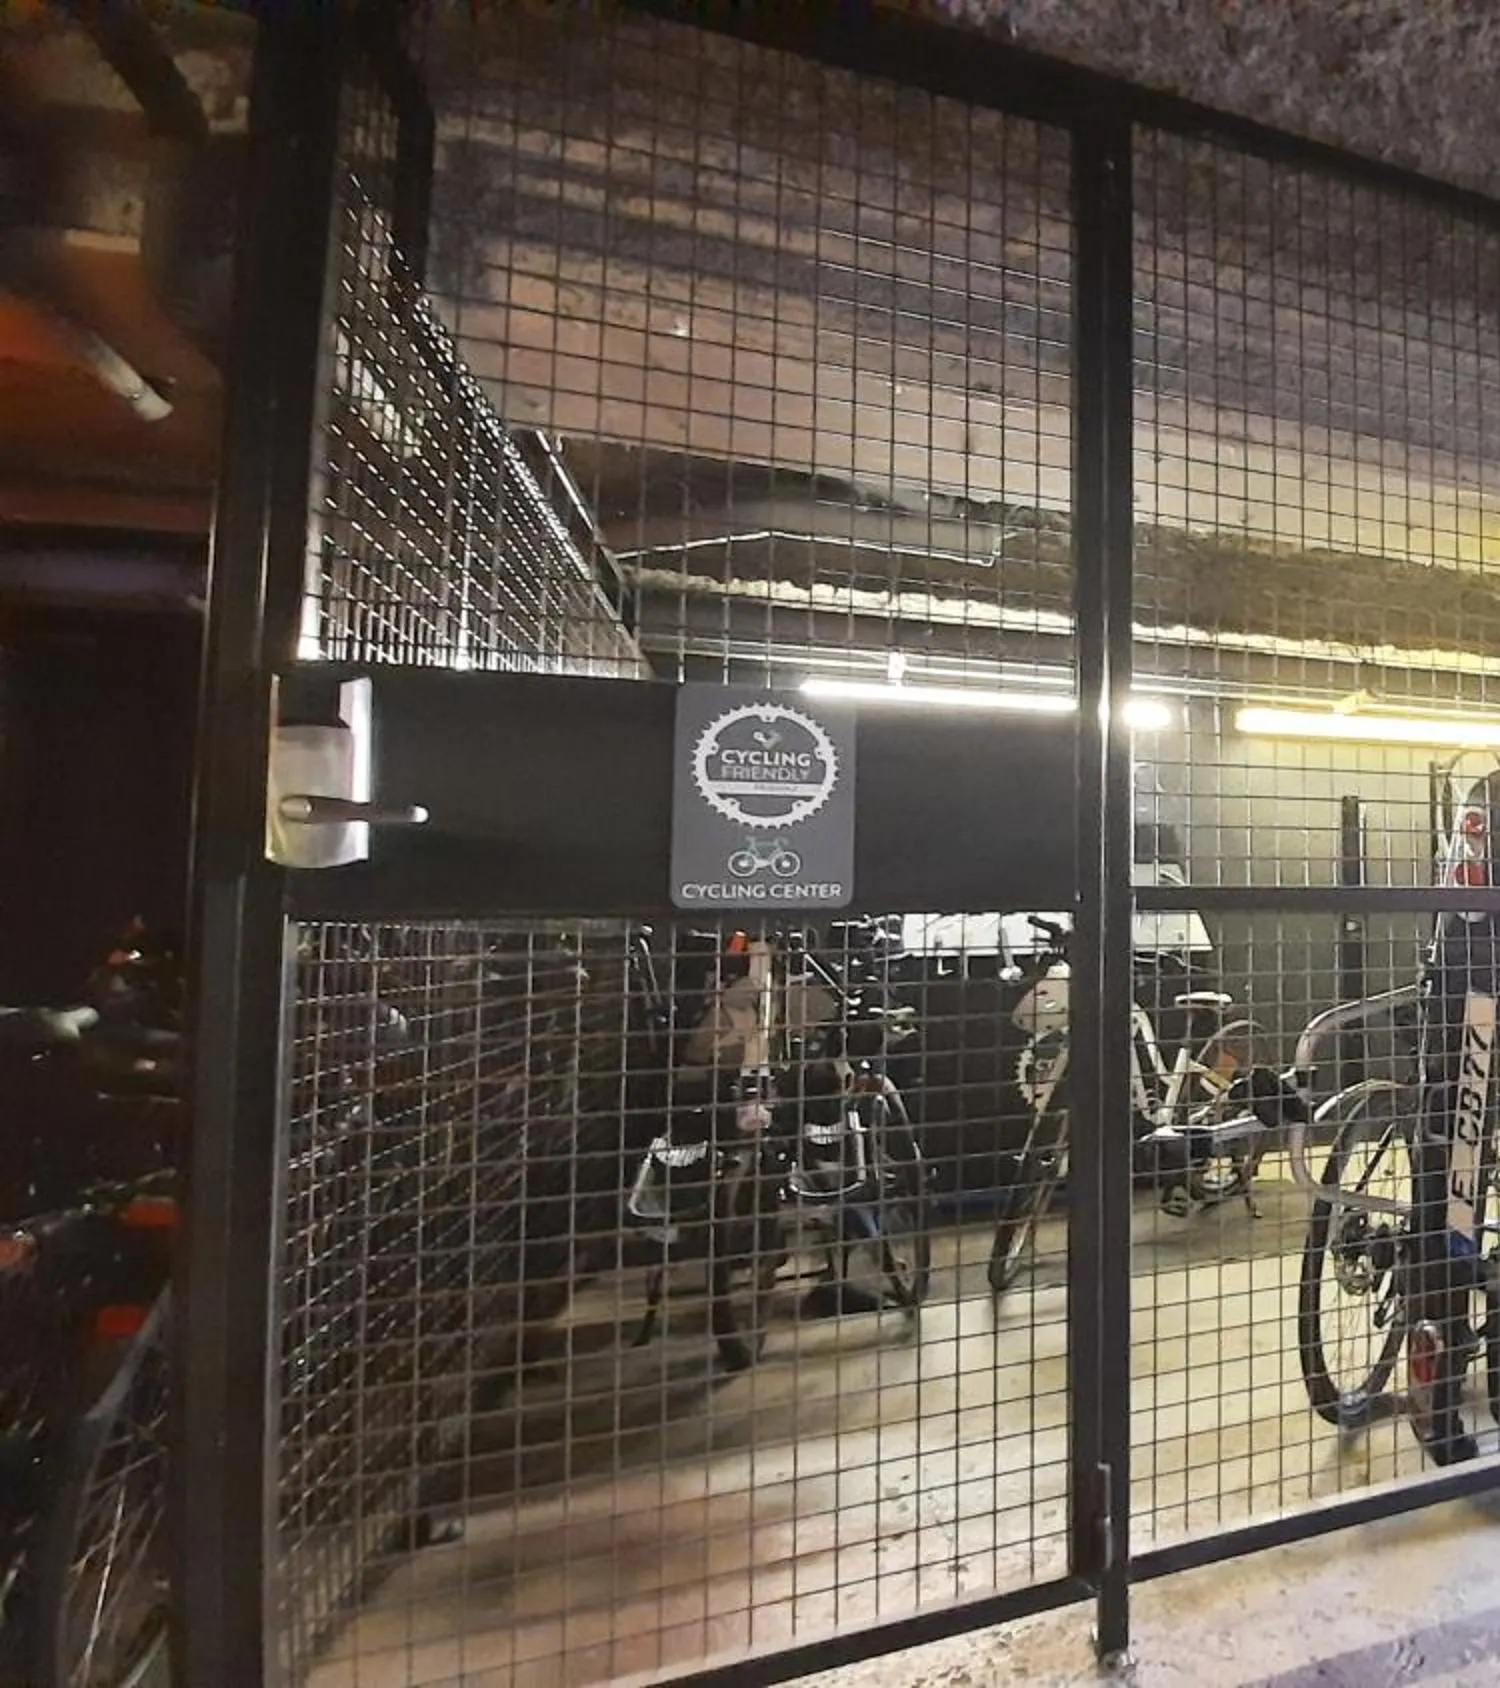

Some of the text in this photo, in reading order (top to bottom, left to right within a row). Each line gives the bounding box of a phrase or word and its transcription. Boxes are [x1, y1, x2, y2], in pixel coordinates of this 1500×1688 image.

[720, 750, 811, 767] CYCLING
[720, 766, 810, 781] FRIENDLY
[681, 883, 842, 899] CYCLING CENTER
